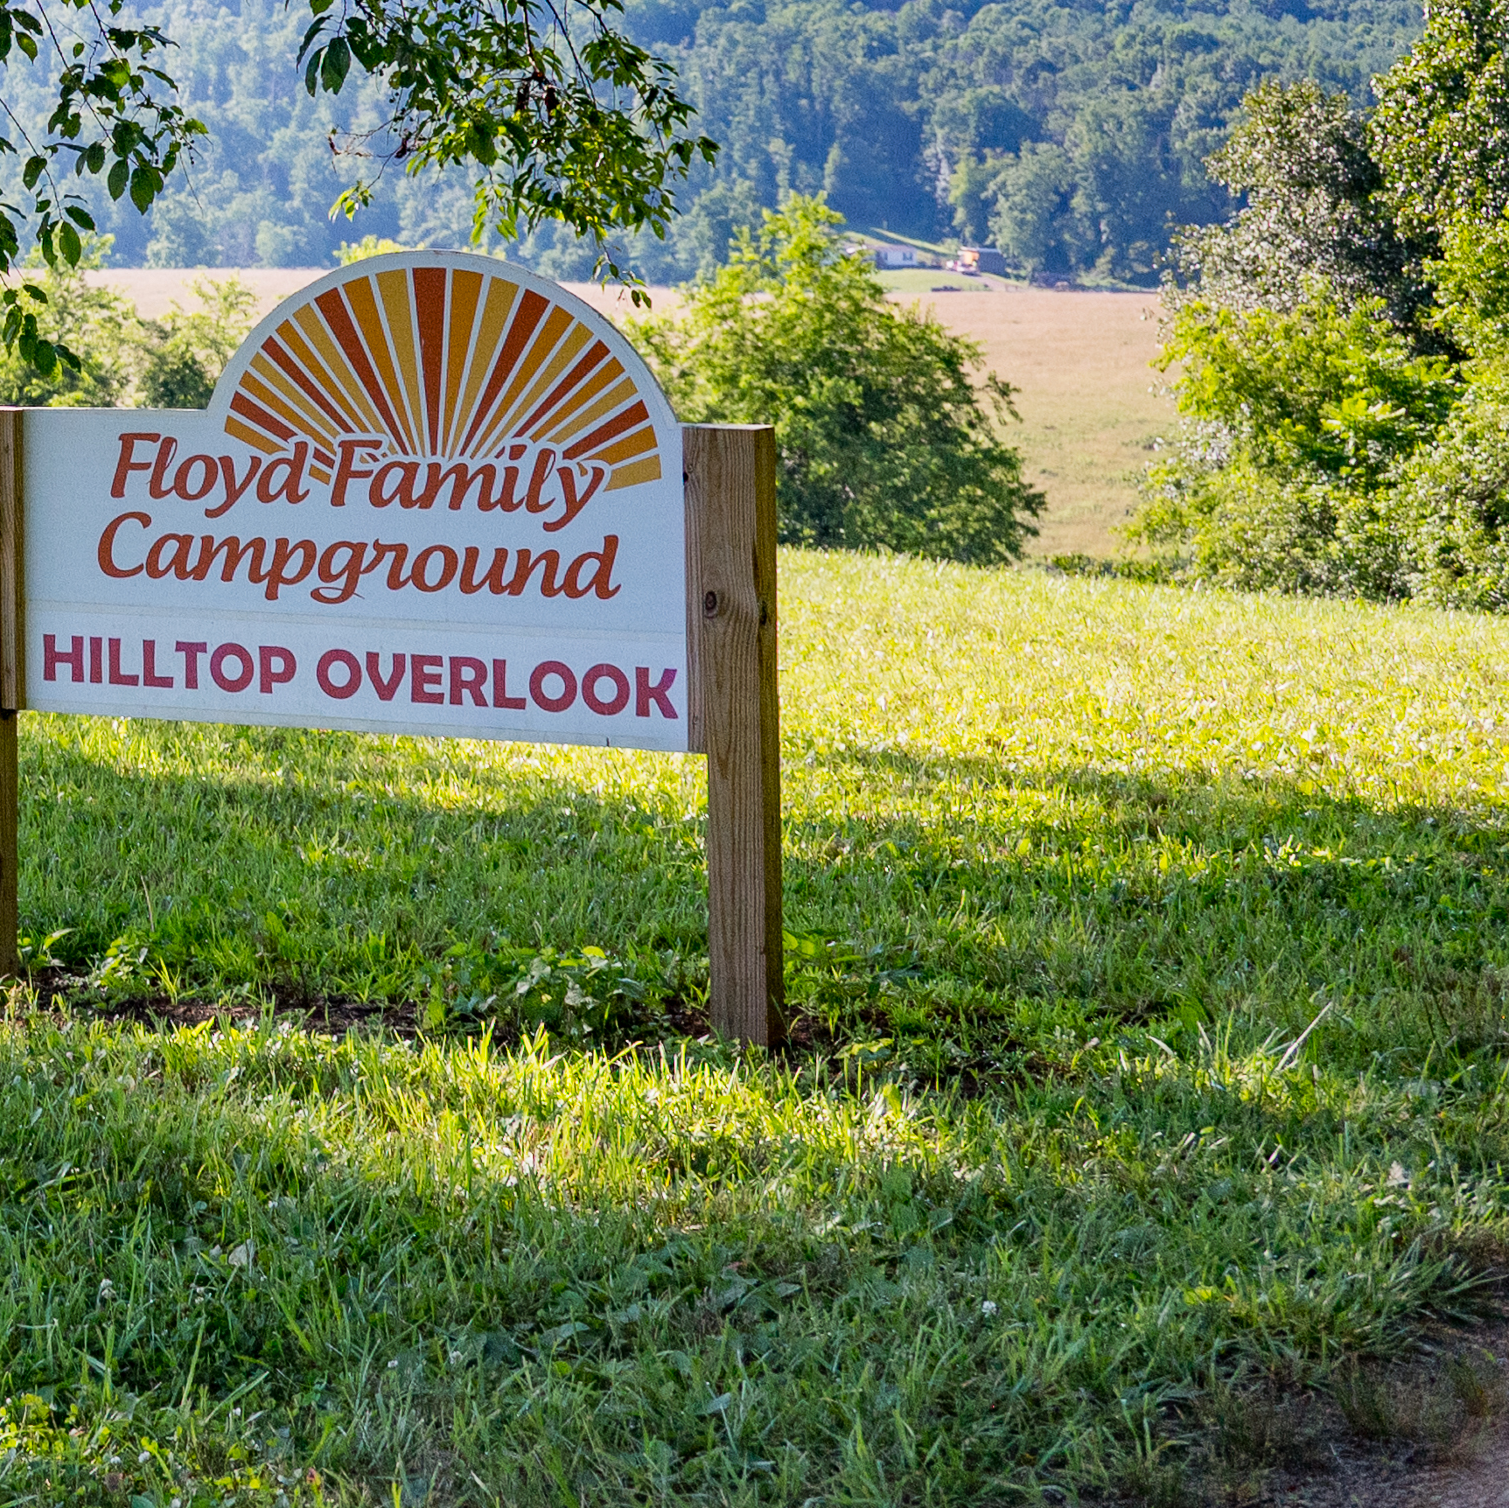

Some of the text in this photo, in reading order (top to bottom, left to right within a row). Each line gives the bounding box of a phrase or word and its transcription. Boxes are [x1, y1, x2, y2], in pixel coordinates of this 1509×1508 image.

[110, 432, 603, 532] Floyd Family
[97, 511, 621, 603] Campground
[42, 634, 678, 719] HILLTOP OVERLOOK
